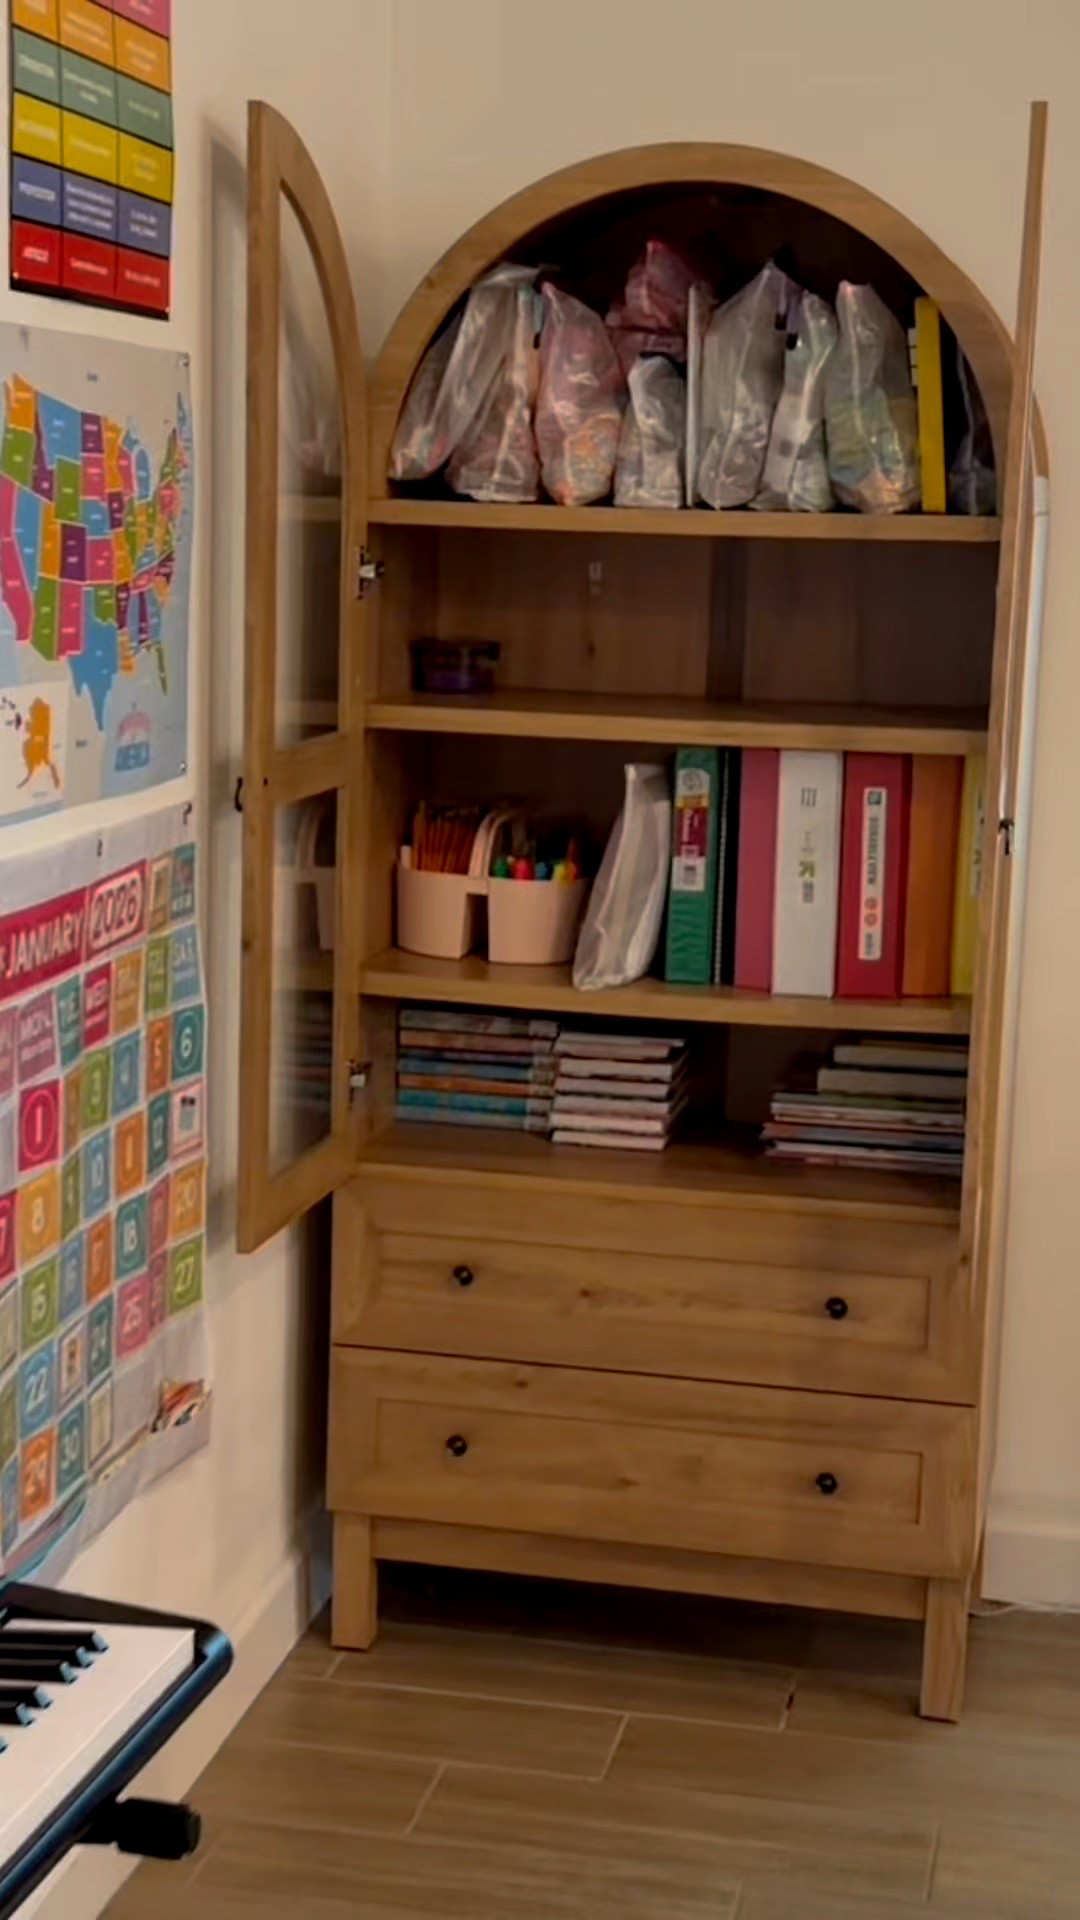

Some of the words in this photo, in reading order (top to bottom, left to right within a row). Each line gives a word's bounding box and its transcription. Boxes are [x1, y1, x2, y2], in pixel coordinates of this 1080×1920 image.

[92, 878, 137, 941] 2026
[6, 911, 83, 980] JANUARY
[180, 1027, 192, 1057] 6
[35, 1104, 43, 1144] 1
[31, 1196, 44, 1234] 8
[175, 1255, 195, 1292] 27
[26, 1366, 48, 1413] 22
[61, 1427, 80, 1469] 30
